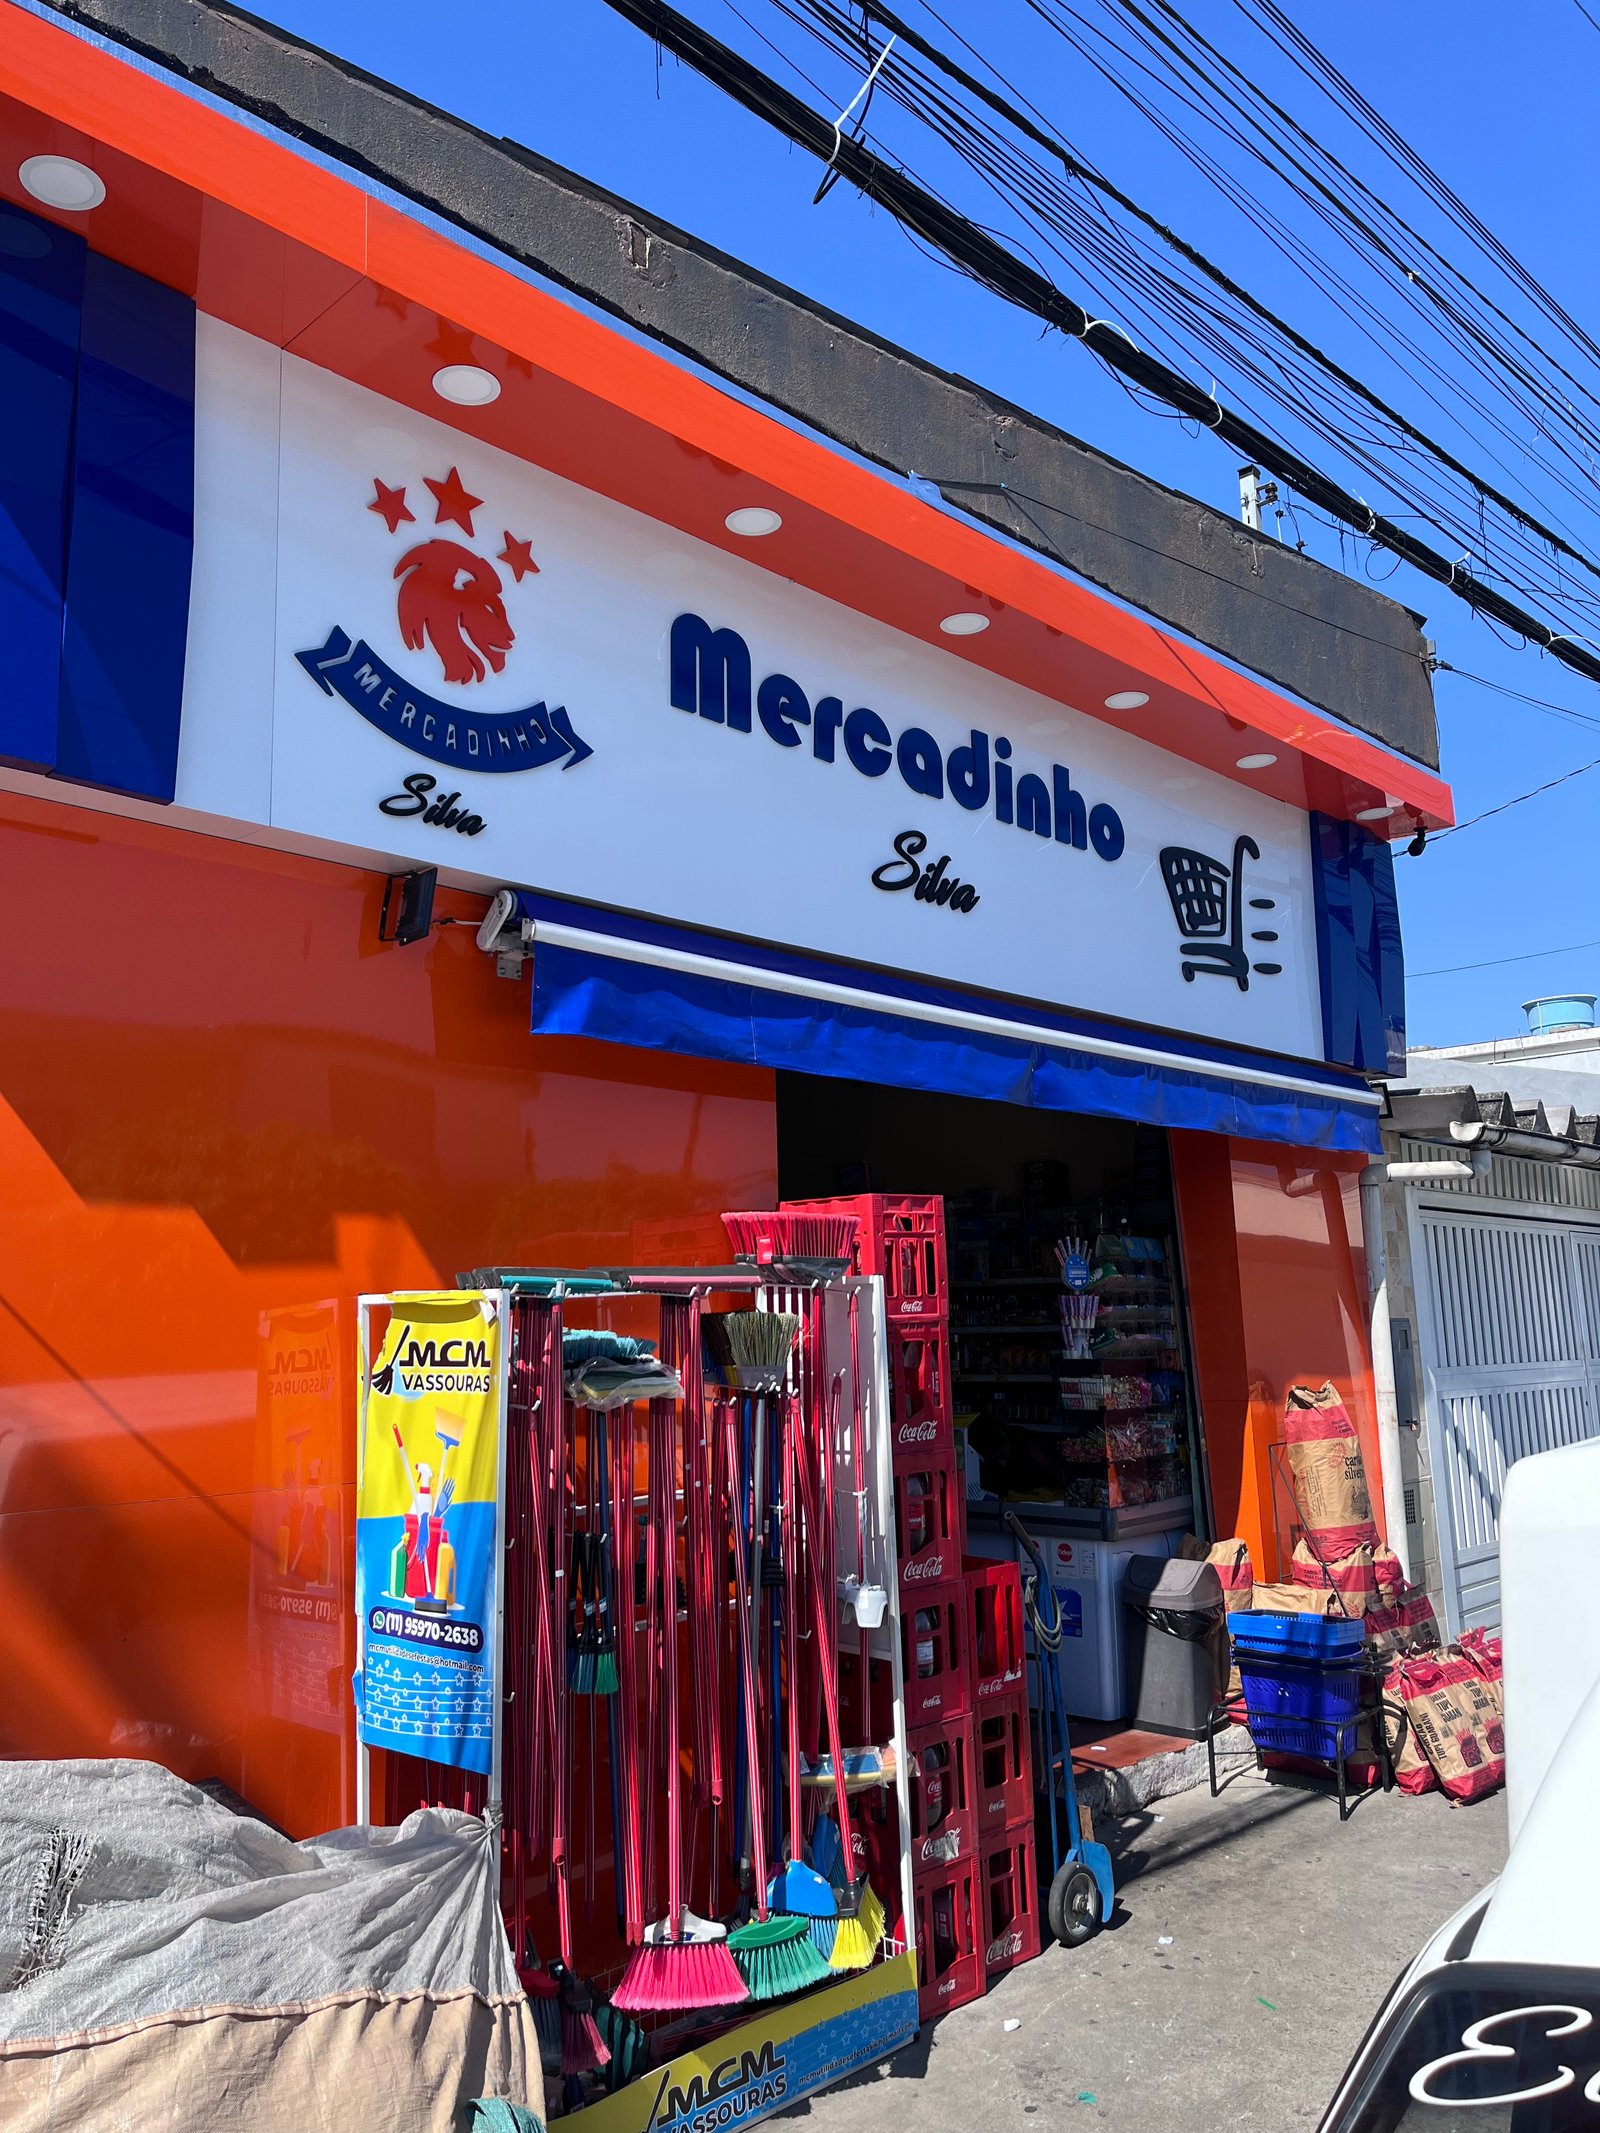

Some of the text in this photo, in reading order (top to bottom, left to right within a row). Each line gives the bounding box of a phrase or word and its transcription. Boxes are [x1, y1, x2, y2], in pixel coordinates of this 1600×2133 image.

[353, 662, 547, 758] MERCADINHO
[379, 773, 488, 836] Silva
[871, 830, 981, 914] Silva
[399, 1340, 491, 1368] MCM
[402, 1373, 490, 1393] VASSOURAS
[386, 1612, 479, 1646] (11) 95970-2638
[368, 1643, 484, 1674] mcmutilidadesefestas@hotmail.com
[656, 2040, 785, 2127] MCM
